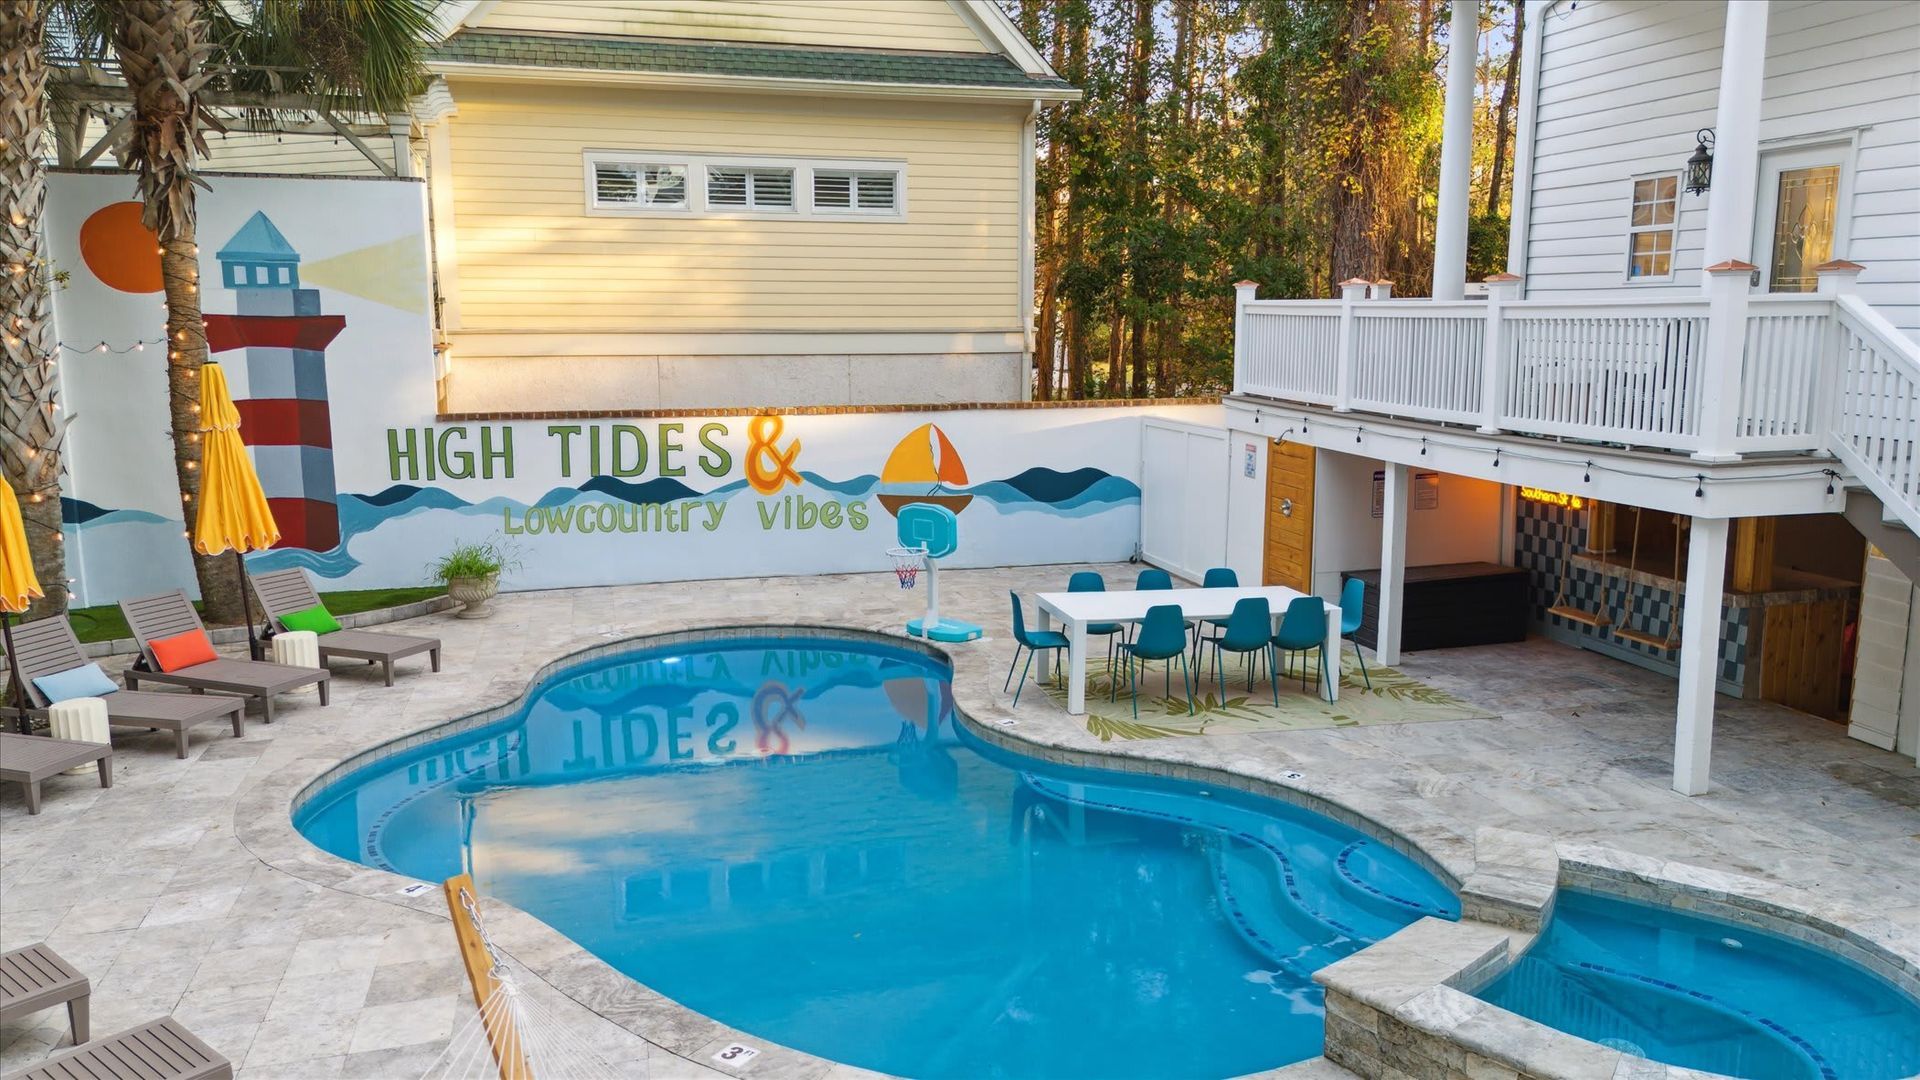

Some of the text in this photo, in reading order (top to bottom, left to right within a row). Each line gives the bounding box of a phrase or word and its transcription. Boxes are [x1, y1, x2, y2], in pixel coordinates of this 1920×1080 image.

[387, 415, 804, 495] HIGH TIDES &
[504, 501, 727, 535] Lowcountry
[721, 1046, 744, 1060] 3
